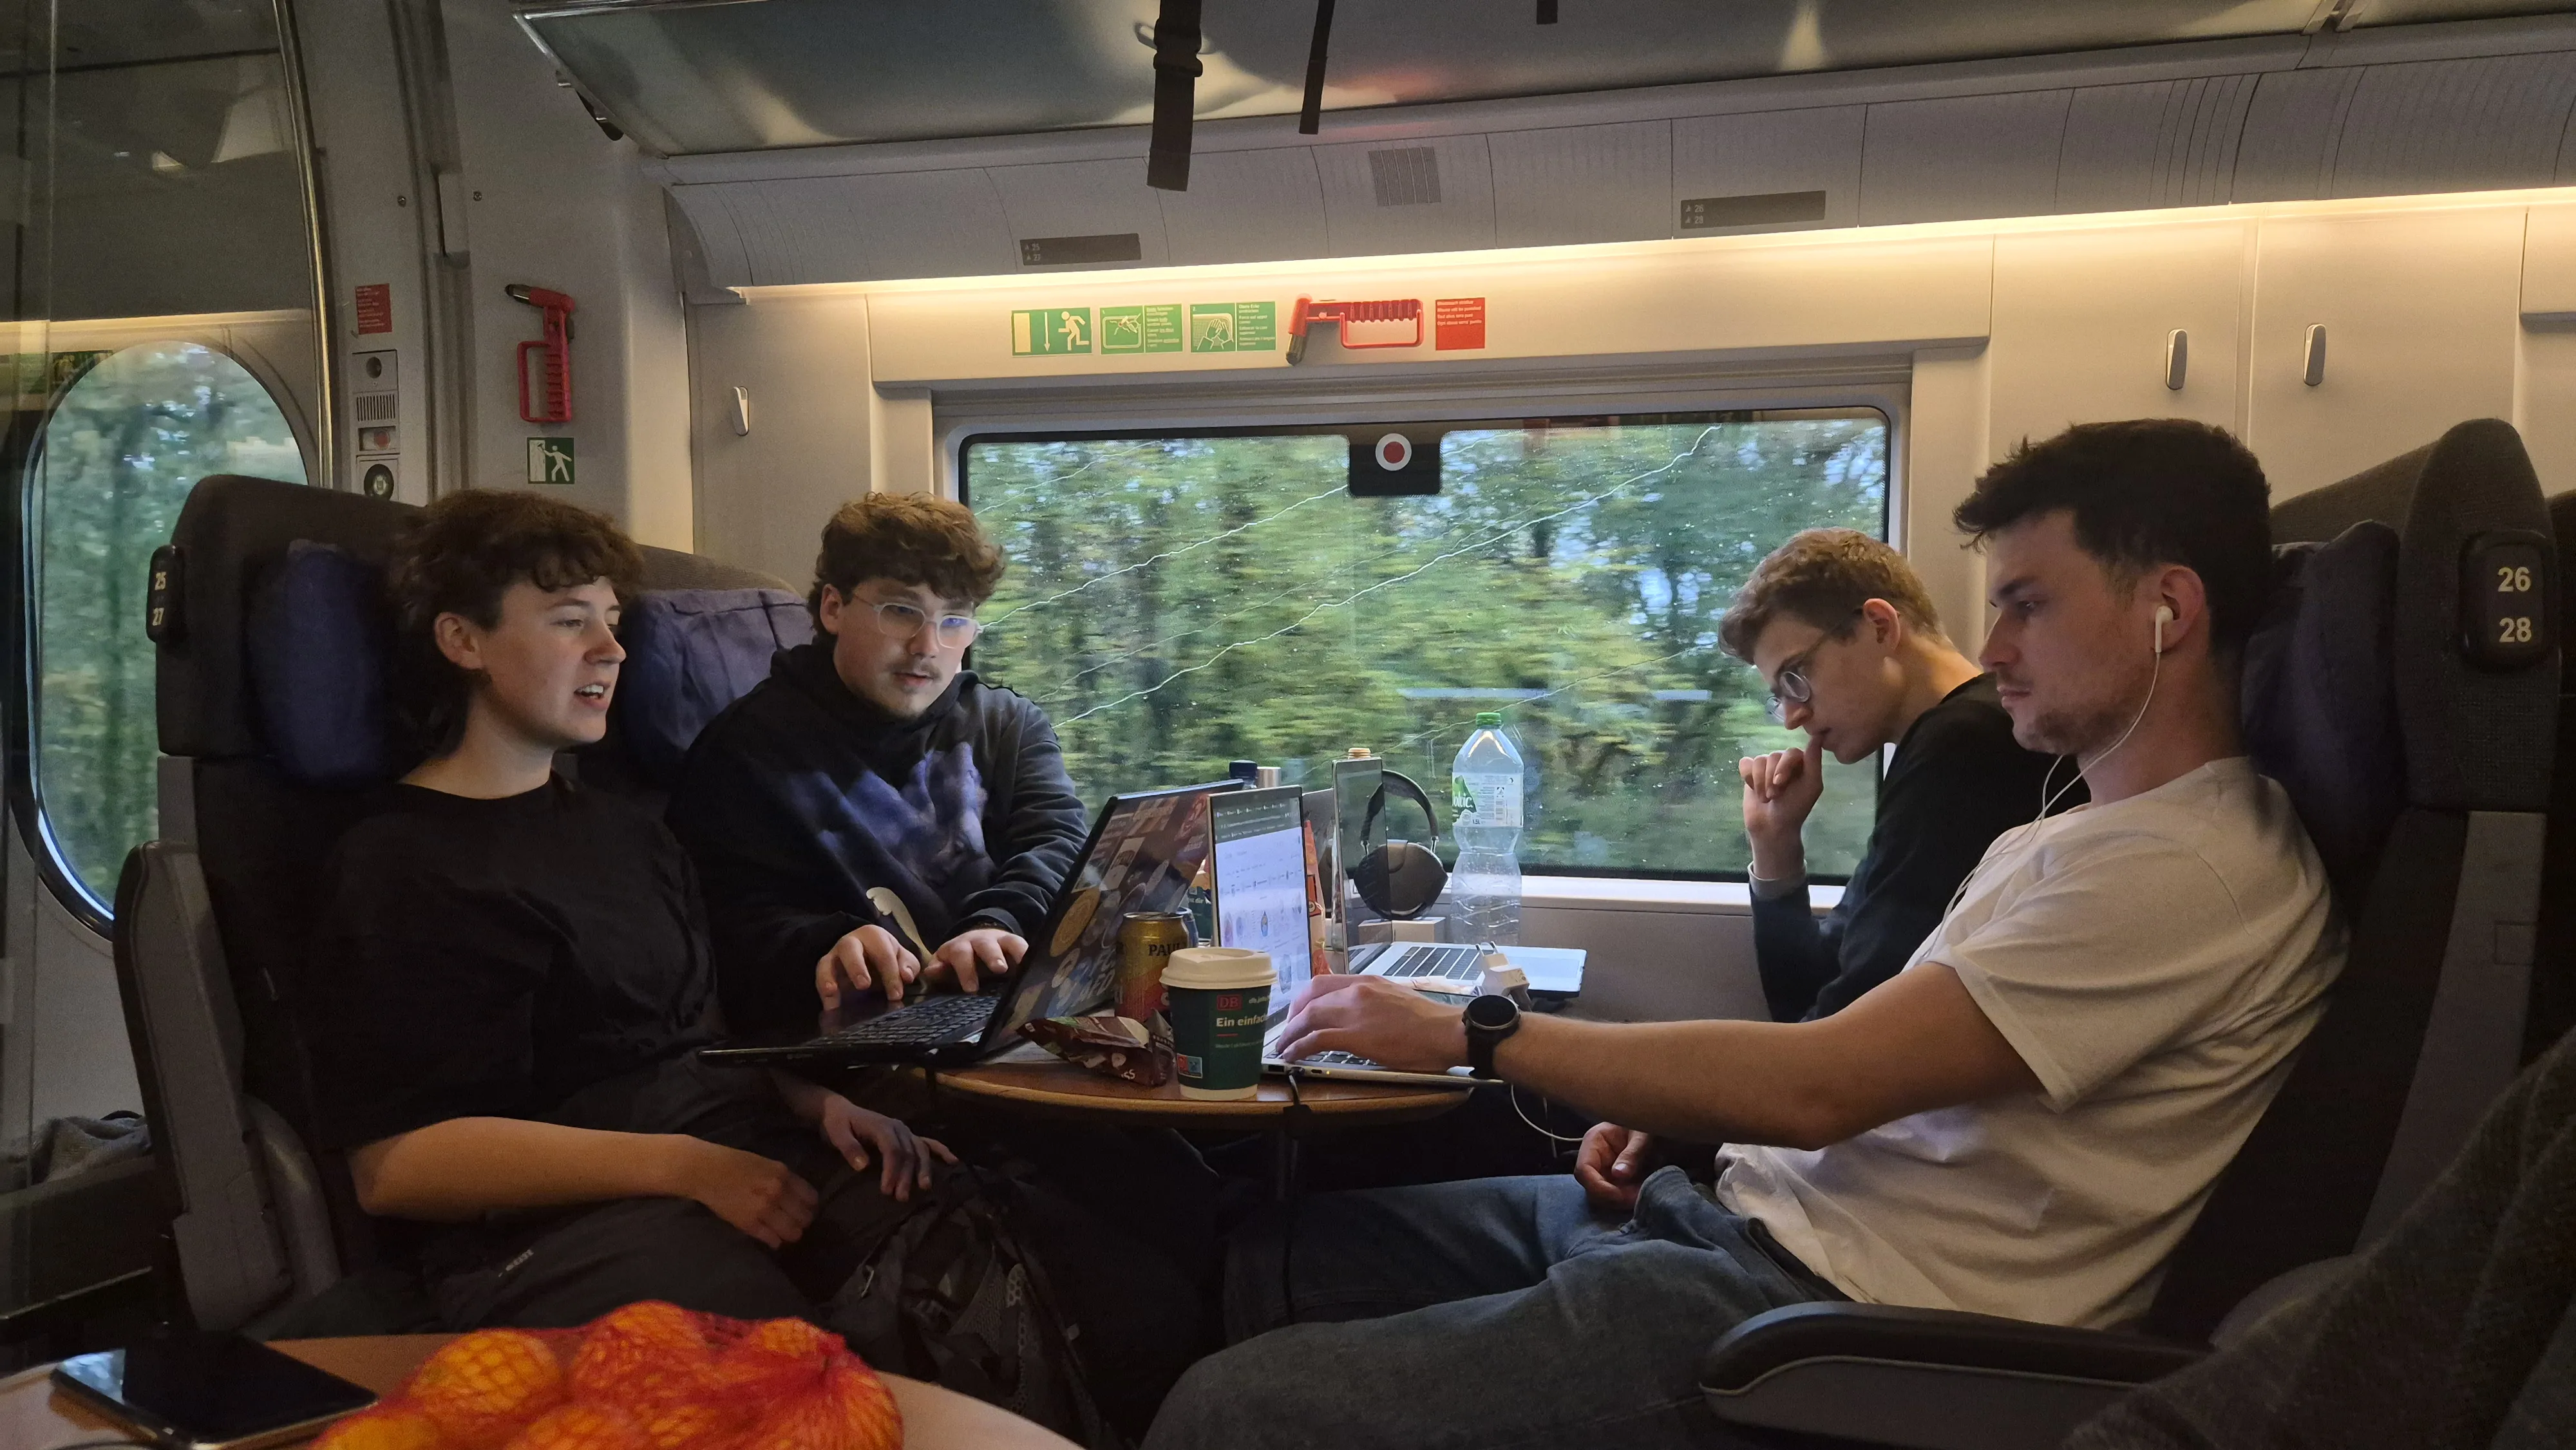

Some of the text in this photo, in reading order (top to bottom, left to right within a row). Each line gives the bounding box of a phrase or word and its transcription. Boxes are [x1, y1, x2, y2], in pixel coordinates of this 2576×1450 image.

[2497, 567, 2532, 592] 26
[2499, 617, 2532, 643] 28
[1148, 943, 1180, 956] PAU
[1219, 997, 1240, 1008] DB
[1216, 1017, 1235, 1027] Ein
